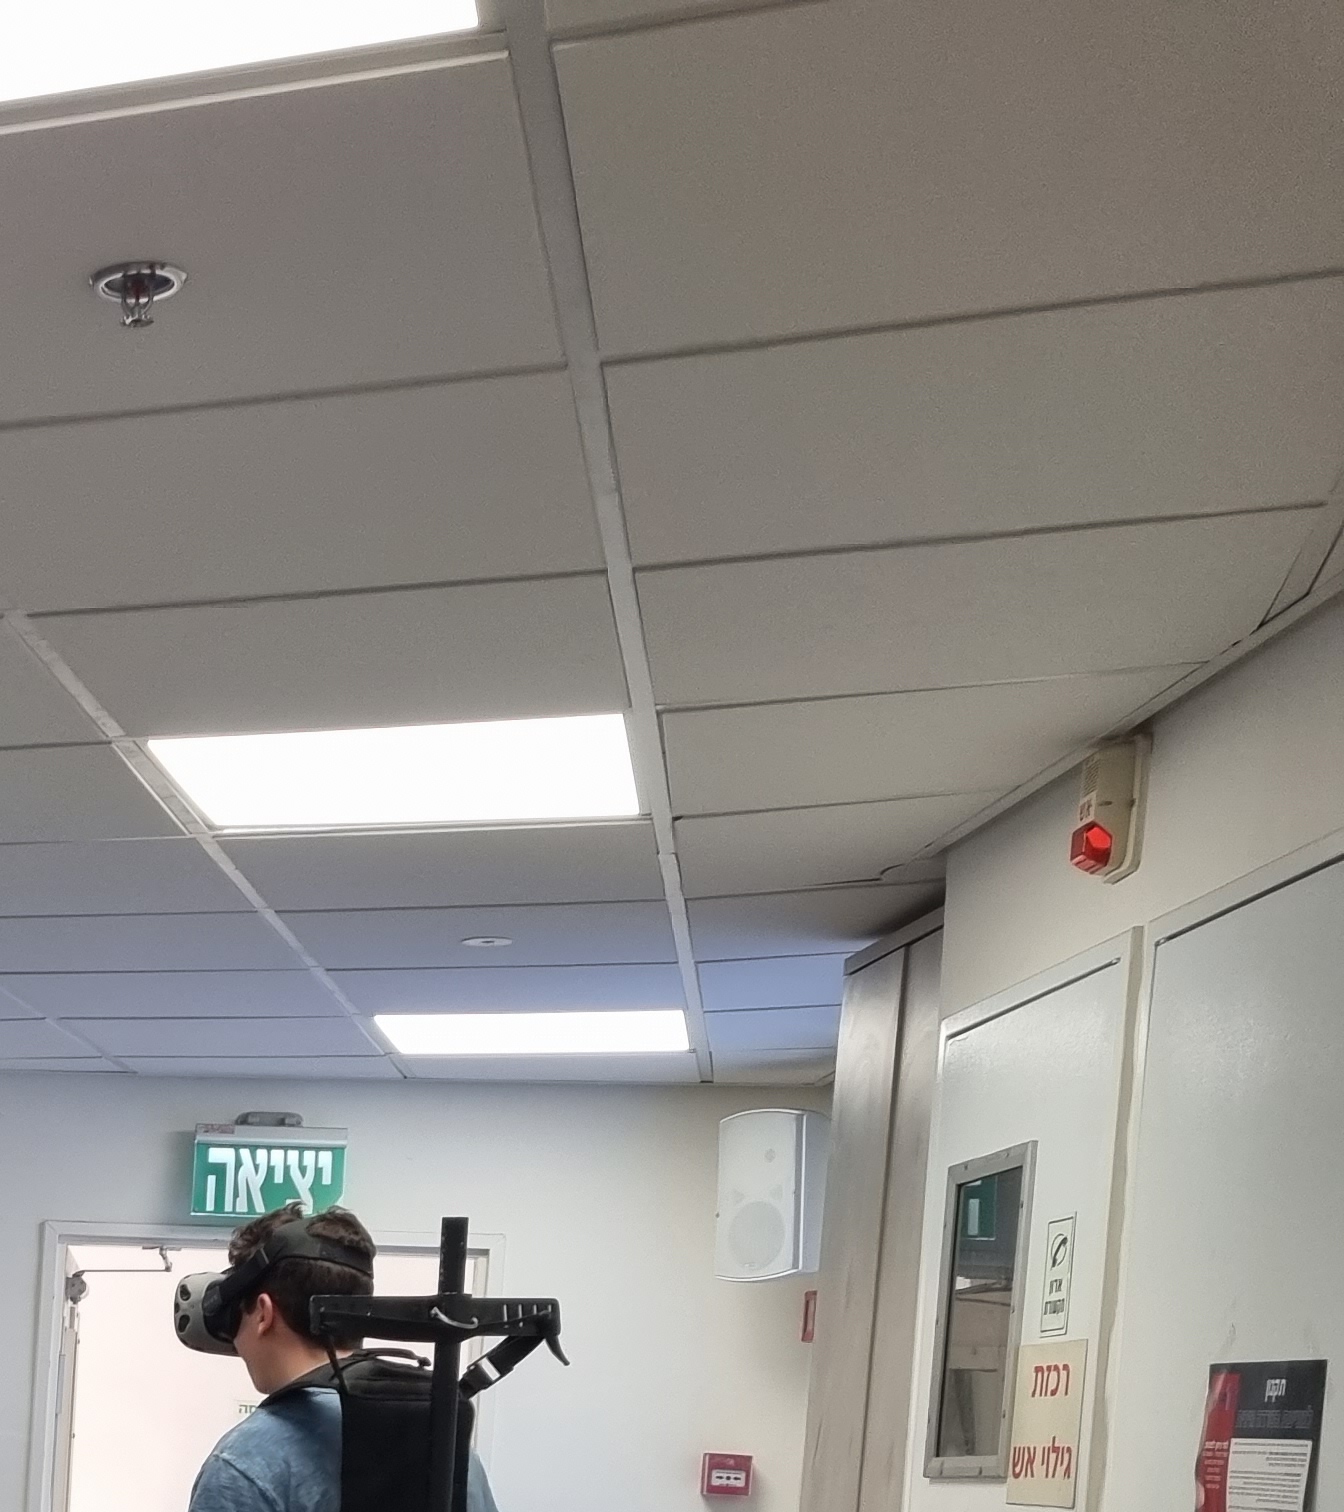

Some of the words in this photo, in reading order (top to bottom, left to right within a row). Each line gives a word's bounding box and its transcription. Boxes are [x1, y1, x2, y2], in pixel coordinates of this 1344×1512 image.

[206, 1147, 332, 1214] יציאה
[1031, 1363, 1070, 1398] רכזת
[1012, 1445, 1036, 1479] אש
[1041, 1436, 1073, 1479] גילוי
